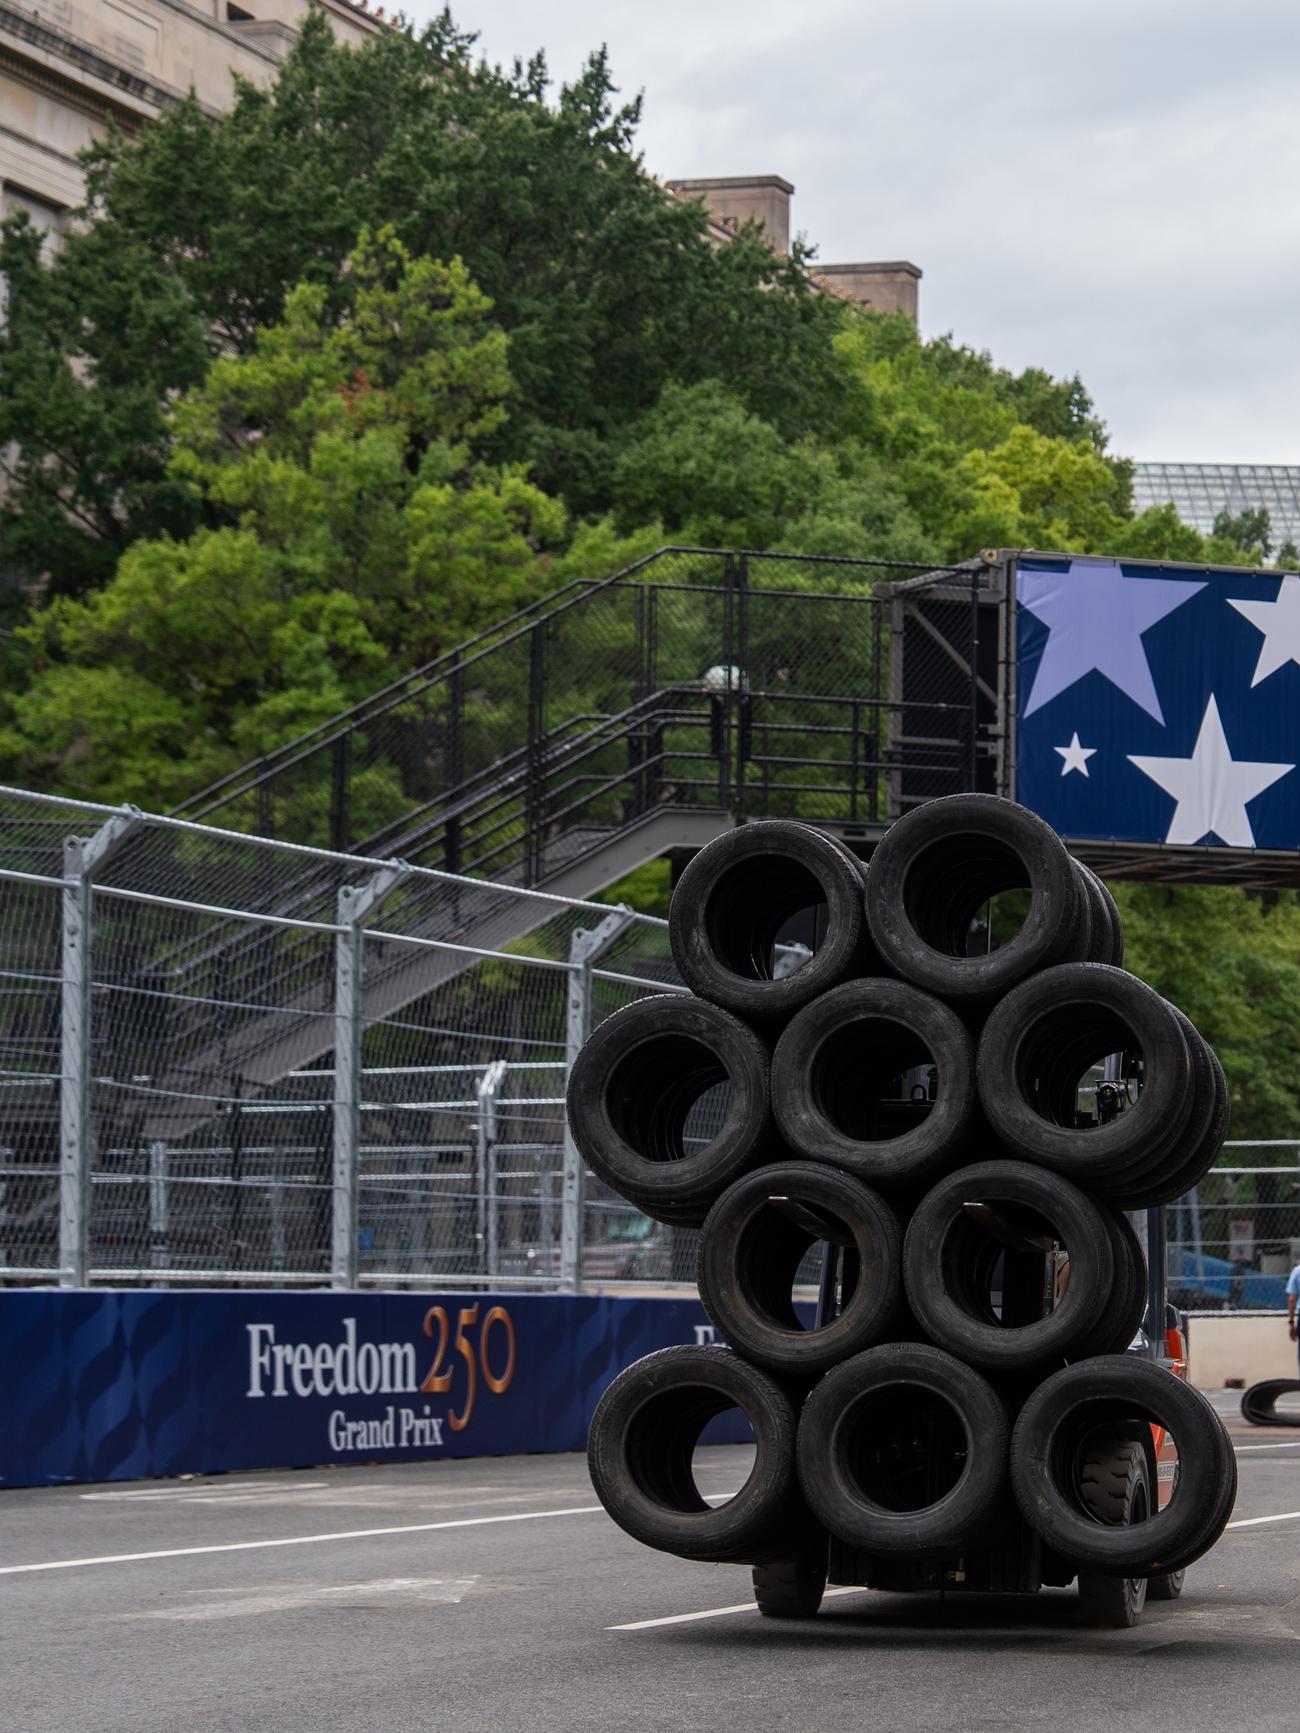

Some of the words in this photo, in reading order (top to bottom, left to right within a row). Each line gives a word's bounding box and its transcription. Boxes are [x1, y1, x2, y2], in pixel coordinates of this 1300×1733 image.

[246, 1317, 418, 1397] Freedom
[419, 1301, 516, 1431] 250
[329, 1406, 395, 1451] Grand
[398, 1405, 444, 1448] Prix
